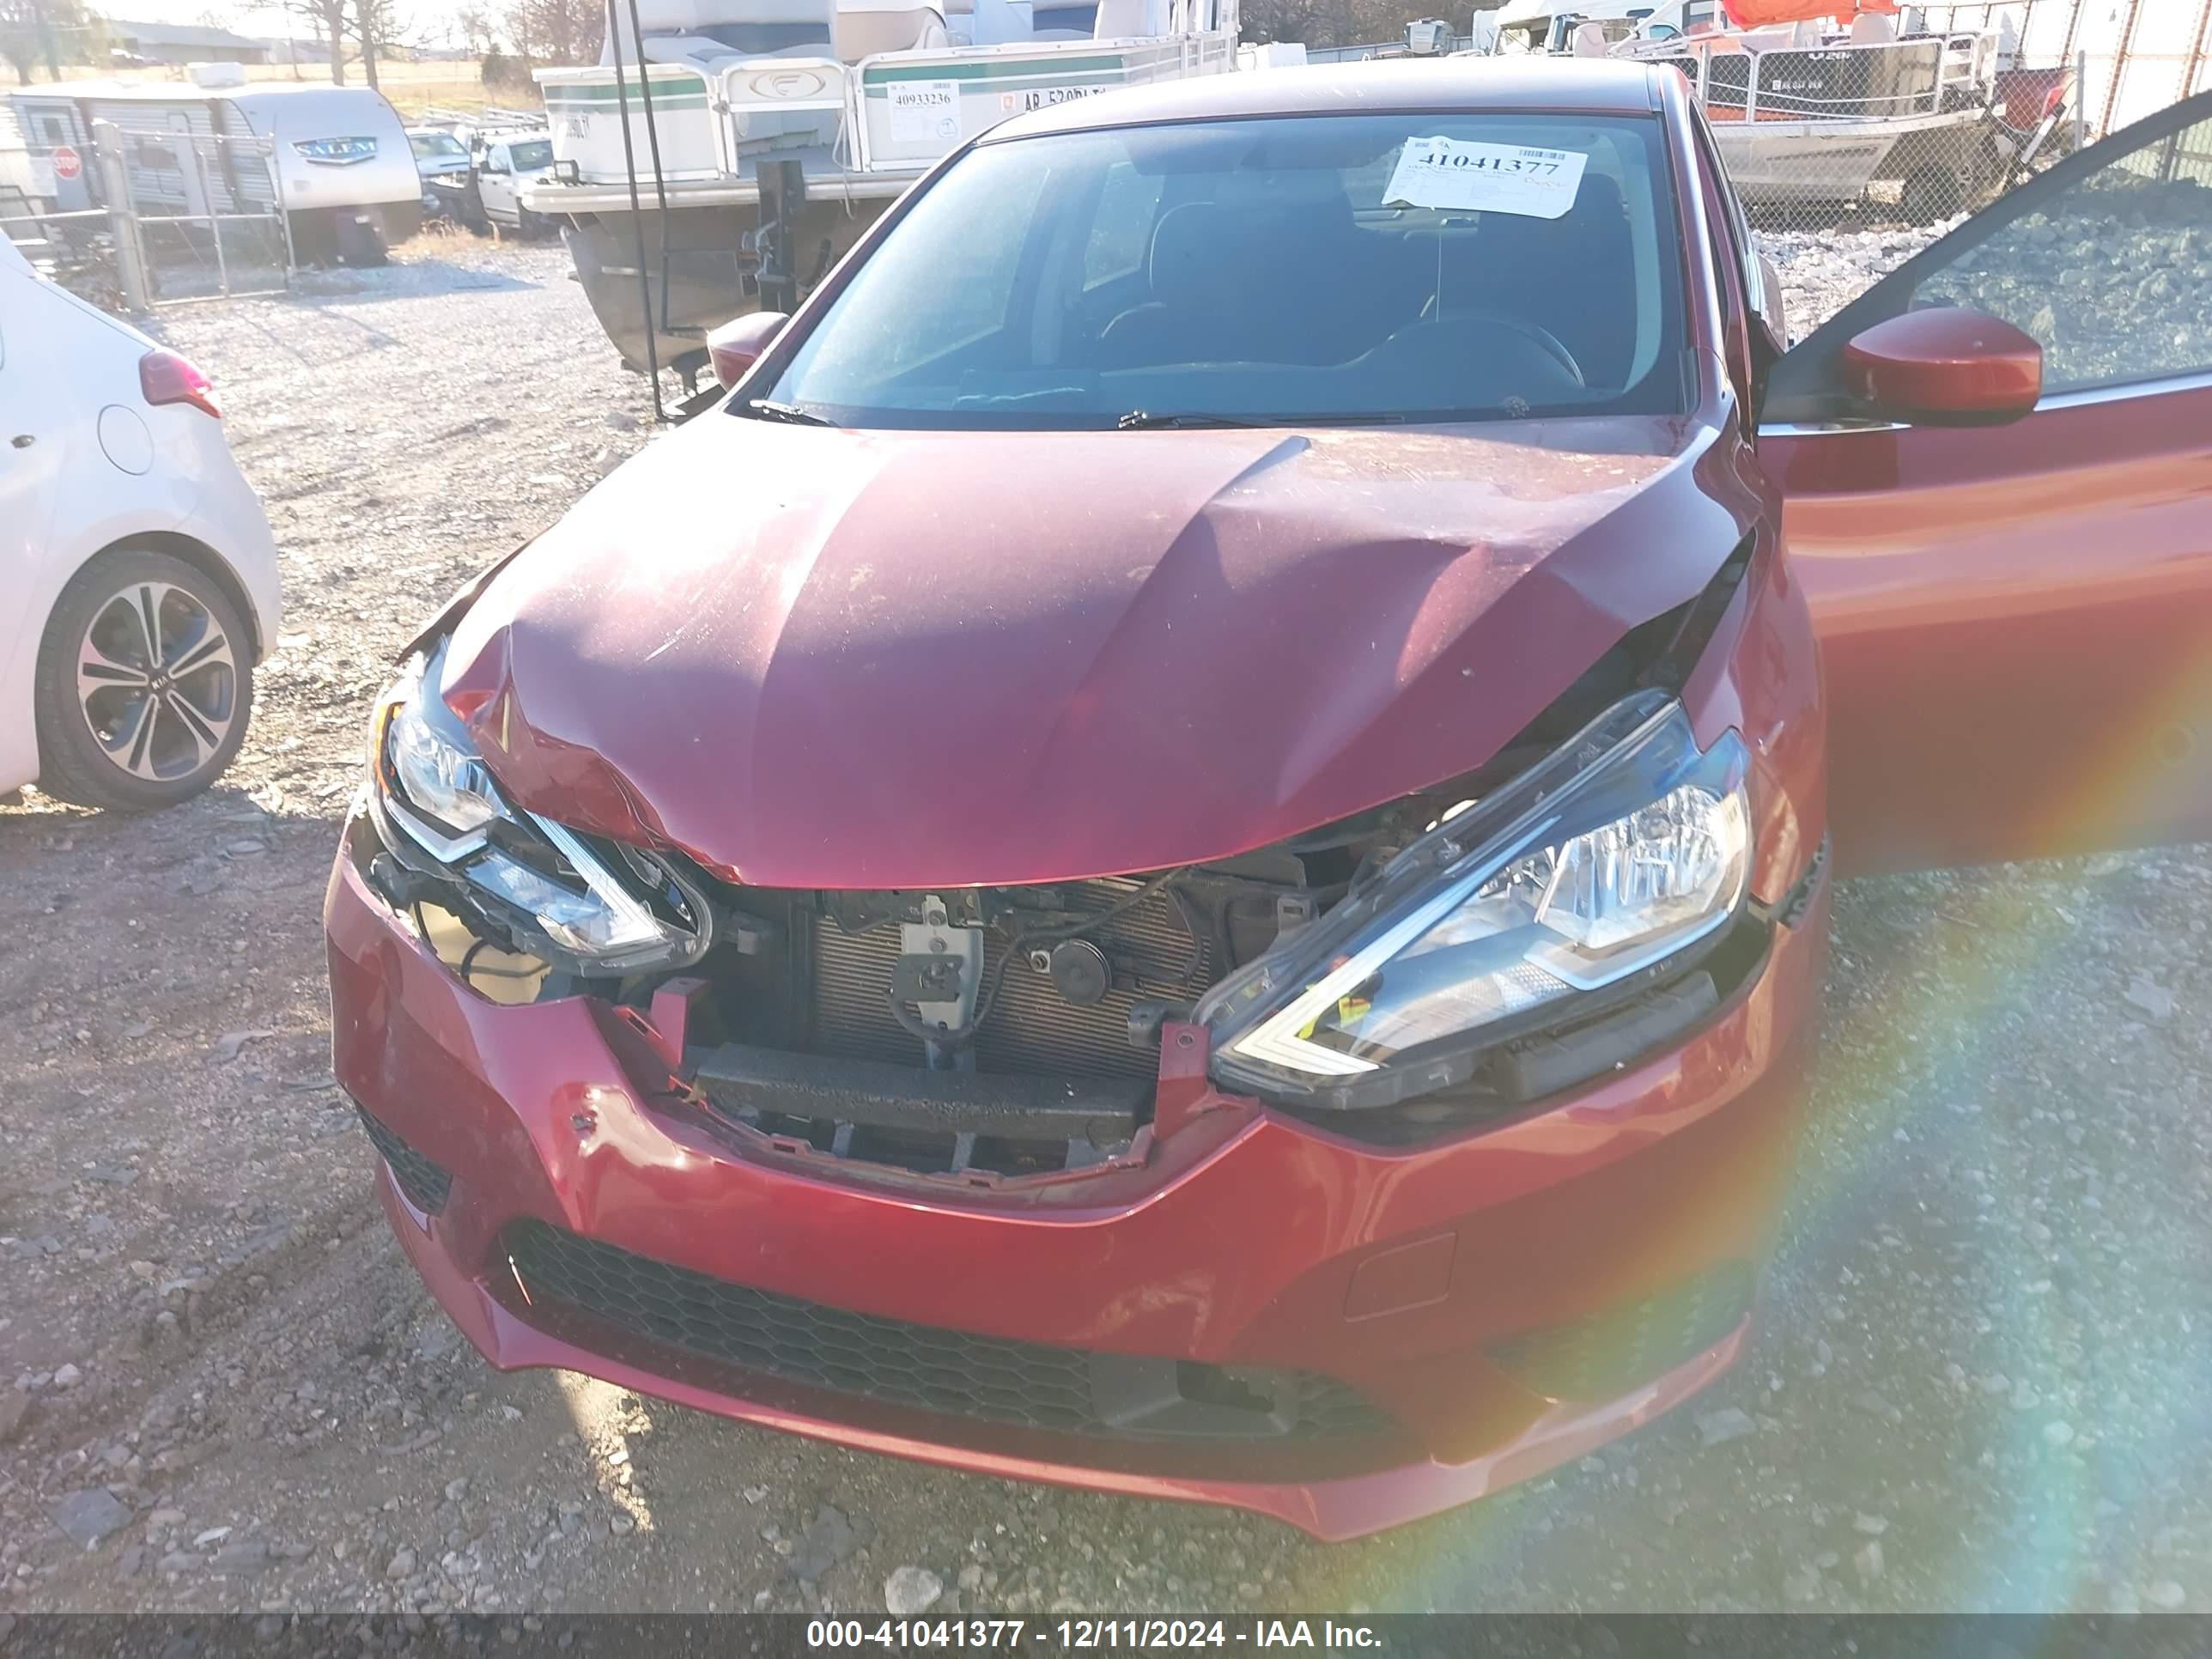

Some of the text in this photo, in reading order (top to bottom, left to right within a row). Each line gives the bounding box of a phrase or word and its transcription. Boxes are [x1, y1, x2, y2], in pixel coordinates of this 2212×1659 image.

[896, 93, 951, 106] 40933236
[54, 156, 81, 170] STOP
[1418, 153, 1560, 175] 41041377
[151, 676, 168, 690] KIA
